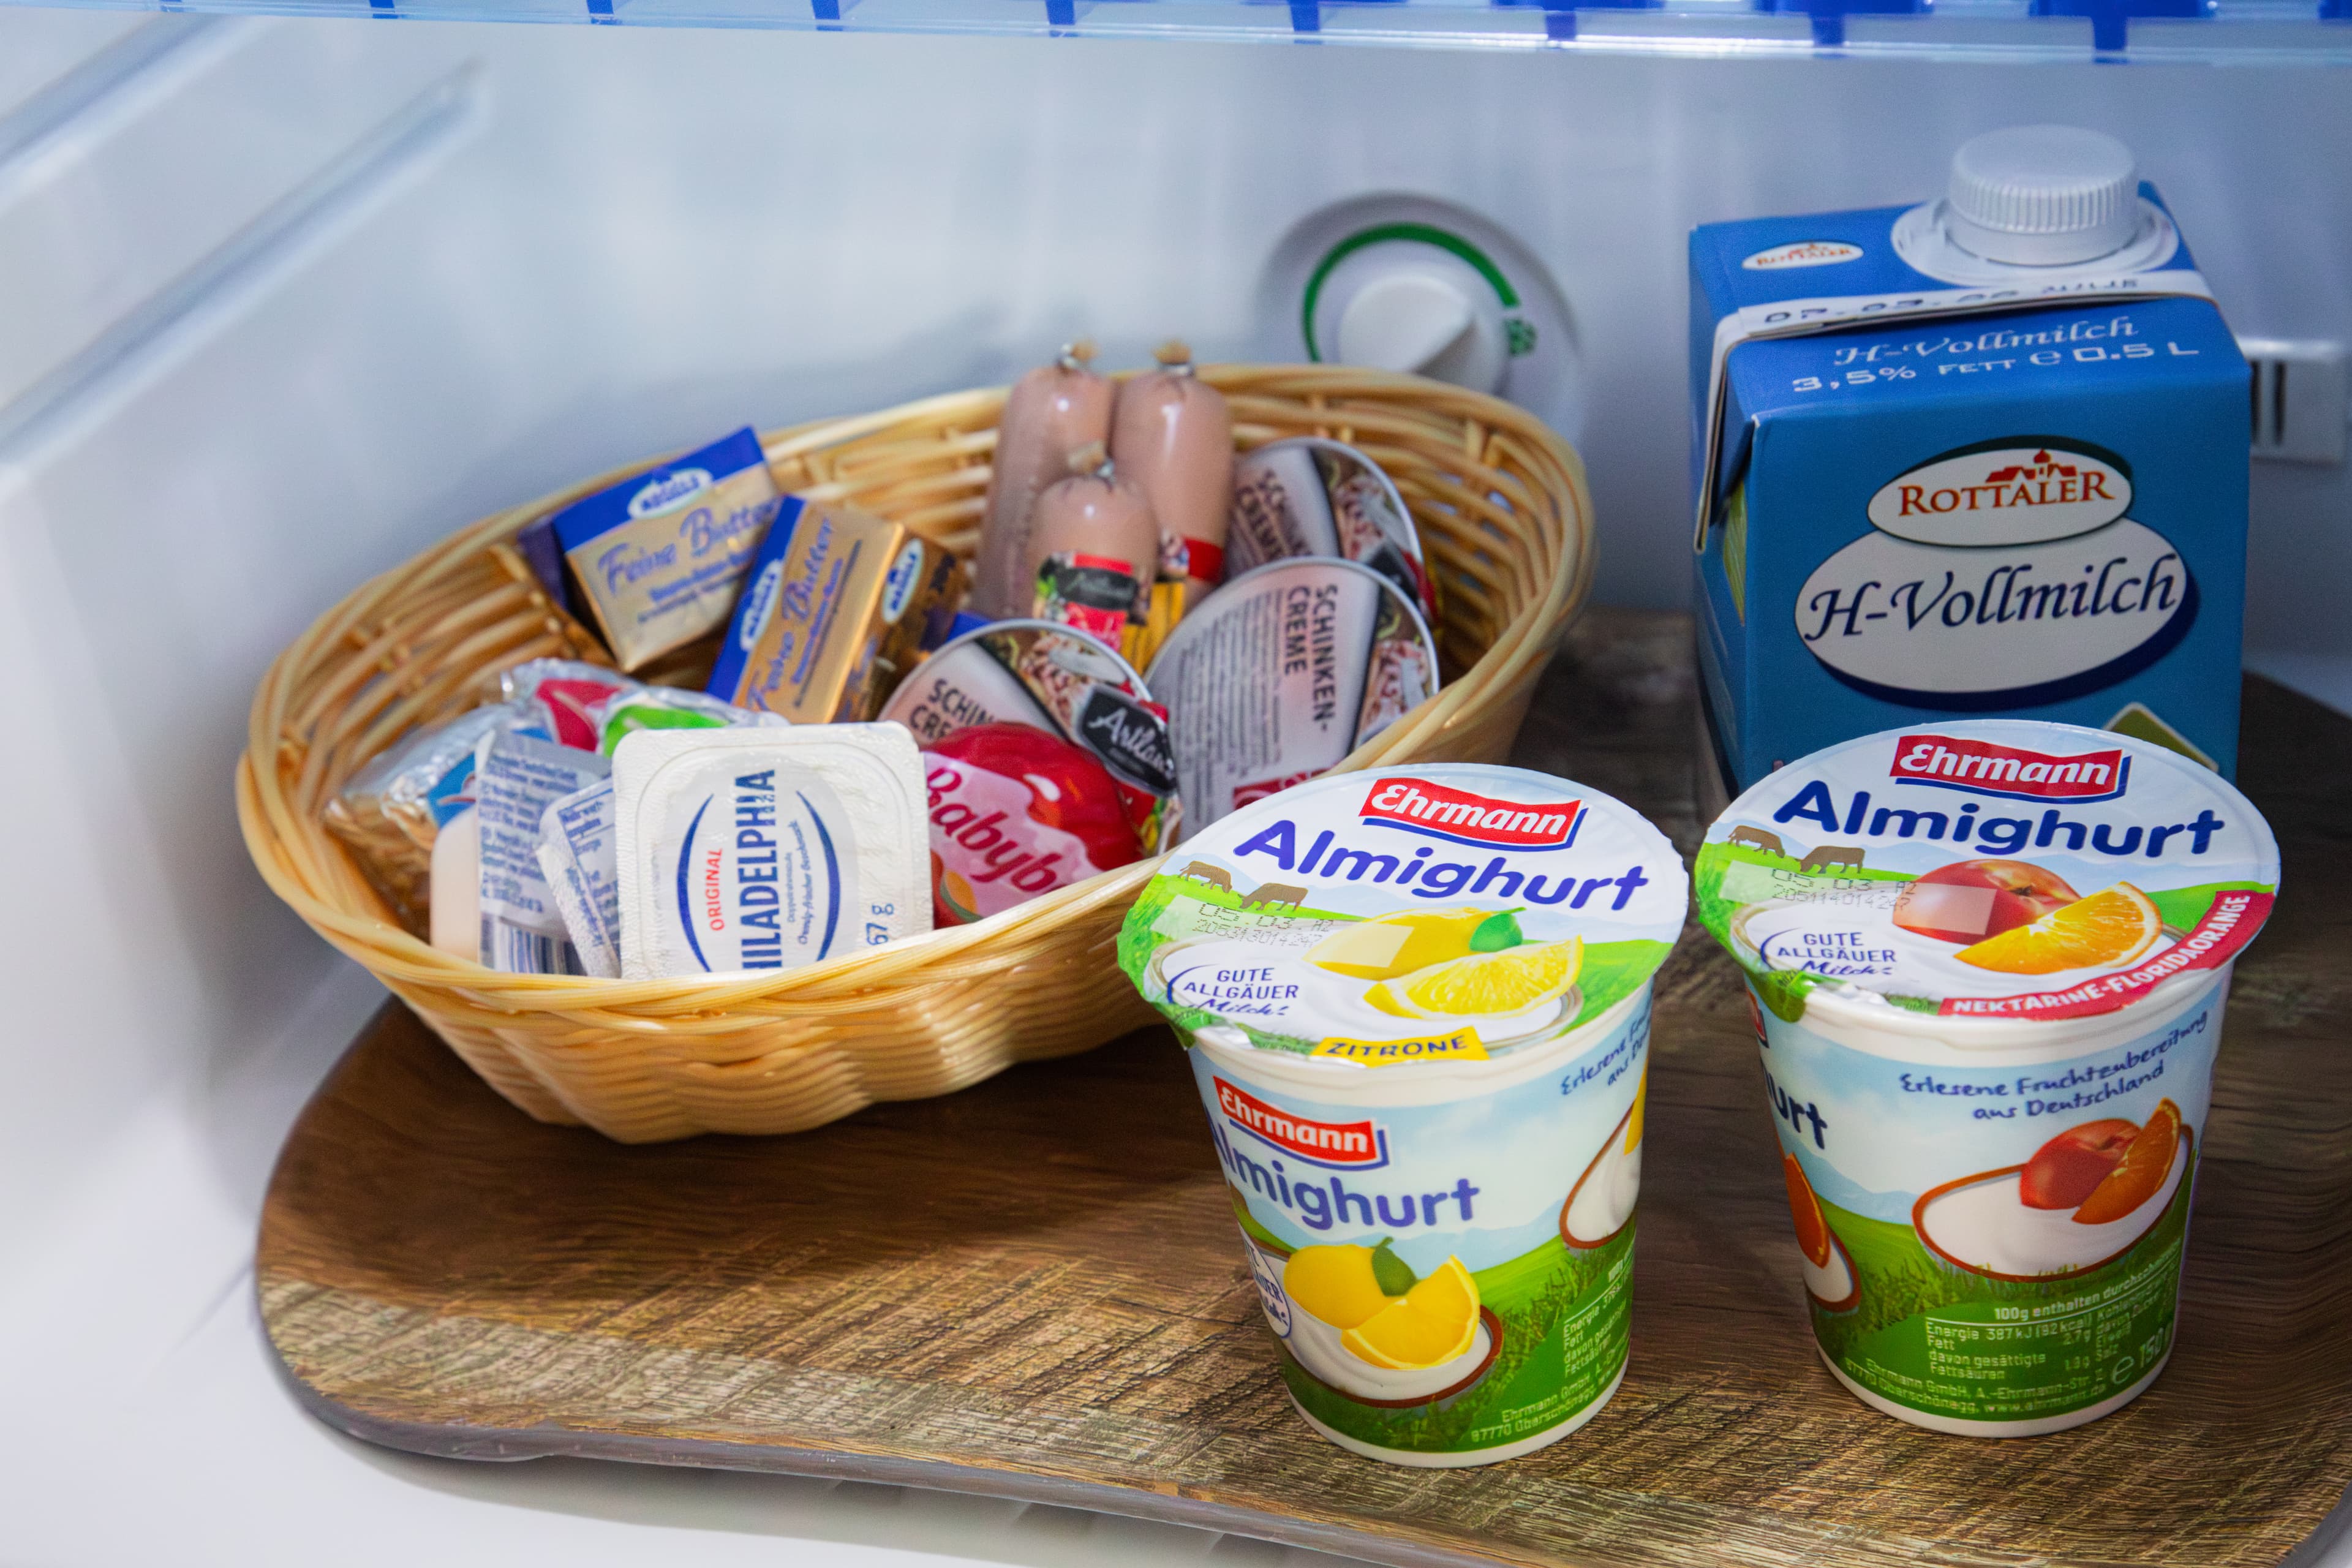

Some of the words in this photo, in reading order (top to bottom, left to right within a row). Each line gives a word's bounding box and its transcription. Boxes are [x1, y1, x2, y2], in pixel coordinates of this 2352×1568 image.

[1834, 316, 2139, 366] H-Vollmilch
[1792, 365, 1917, 392] 3,5%
[1937, 358, 2016, 376] FETT
[2168, 341, 2200, 356] L
[1898, 470, 2116, 518] ROTTALER
[1803, 552, 2178, 642] H-Vollmilch
[1284, 584, 1310, 676] CREME
[1312, 584, 1338, 731] SCHINKEN-
[1899, 744, 2111, 786] Ehrmann
[927, 767, 1065, 892] Babyb
[1371, 781, 1566, 836] Ehrmann
[1773, 780, 2225, 858] Almighurt
[705, 848, 725, 932] ORIGINAL
[734, 769, 783, 970] ILADELPHIA
[1232, 819, 1649, 912] Almighurt
[865, 922, 889, 946] 67
[872, 903, 895, 916] g
[1777, 947, 1897, 963] ALLGÄUER
[1804, 932, 1863, 947] GUTE
[1953, 894, 2251, 1013] NEKTARINE-FLORIDAORANGE
[1183, 981, 1299, 1000] ALLGÄUER
[1216, 967, 1275, 982] GUTE
[1326, 1033, 1469, 1056] ZITRONE
[1899, 1073, 2010, 1097] Erlesene
[2017, 1011, 2208, 1095] Fruchtzubereitung
[1972, 1107, 2017, 1120] aus
[2026, 1059, 2165, 1118] Deutschland
[1221, 1085, 1368, 1153] Ehrmann
[1926, 1321, 1980, 1342] Energie
[1994, 1306, 2029, 1322] 100g
[2033, 1292, 2101, 1317] enthalten
[1927, 1335, 1955, 1351] Fett
[1929, 1349, 1971, 1365] davon
[1973, 1352, 2047, 1369] gesättigte
